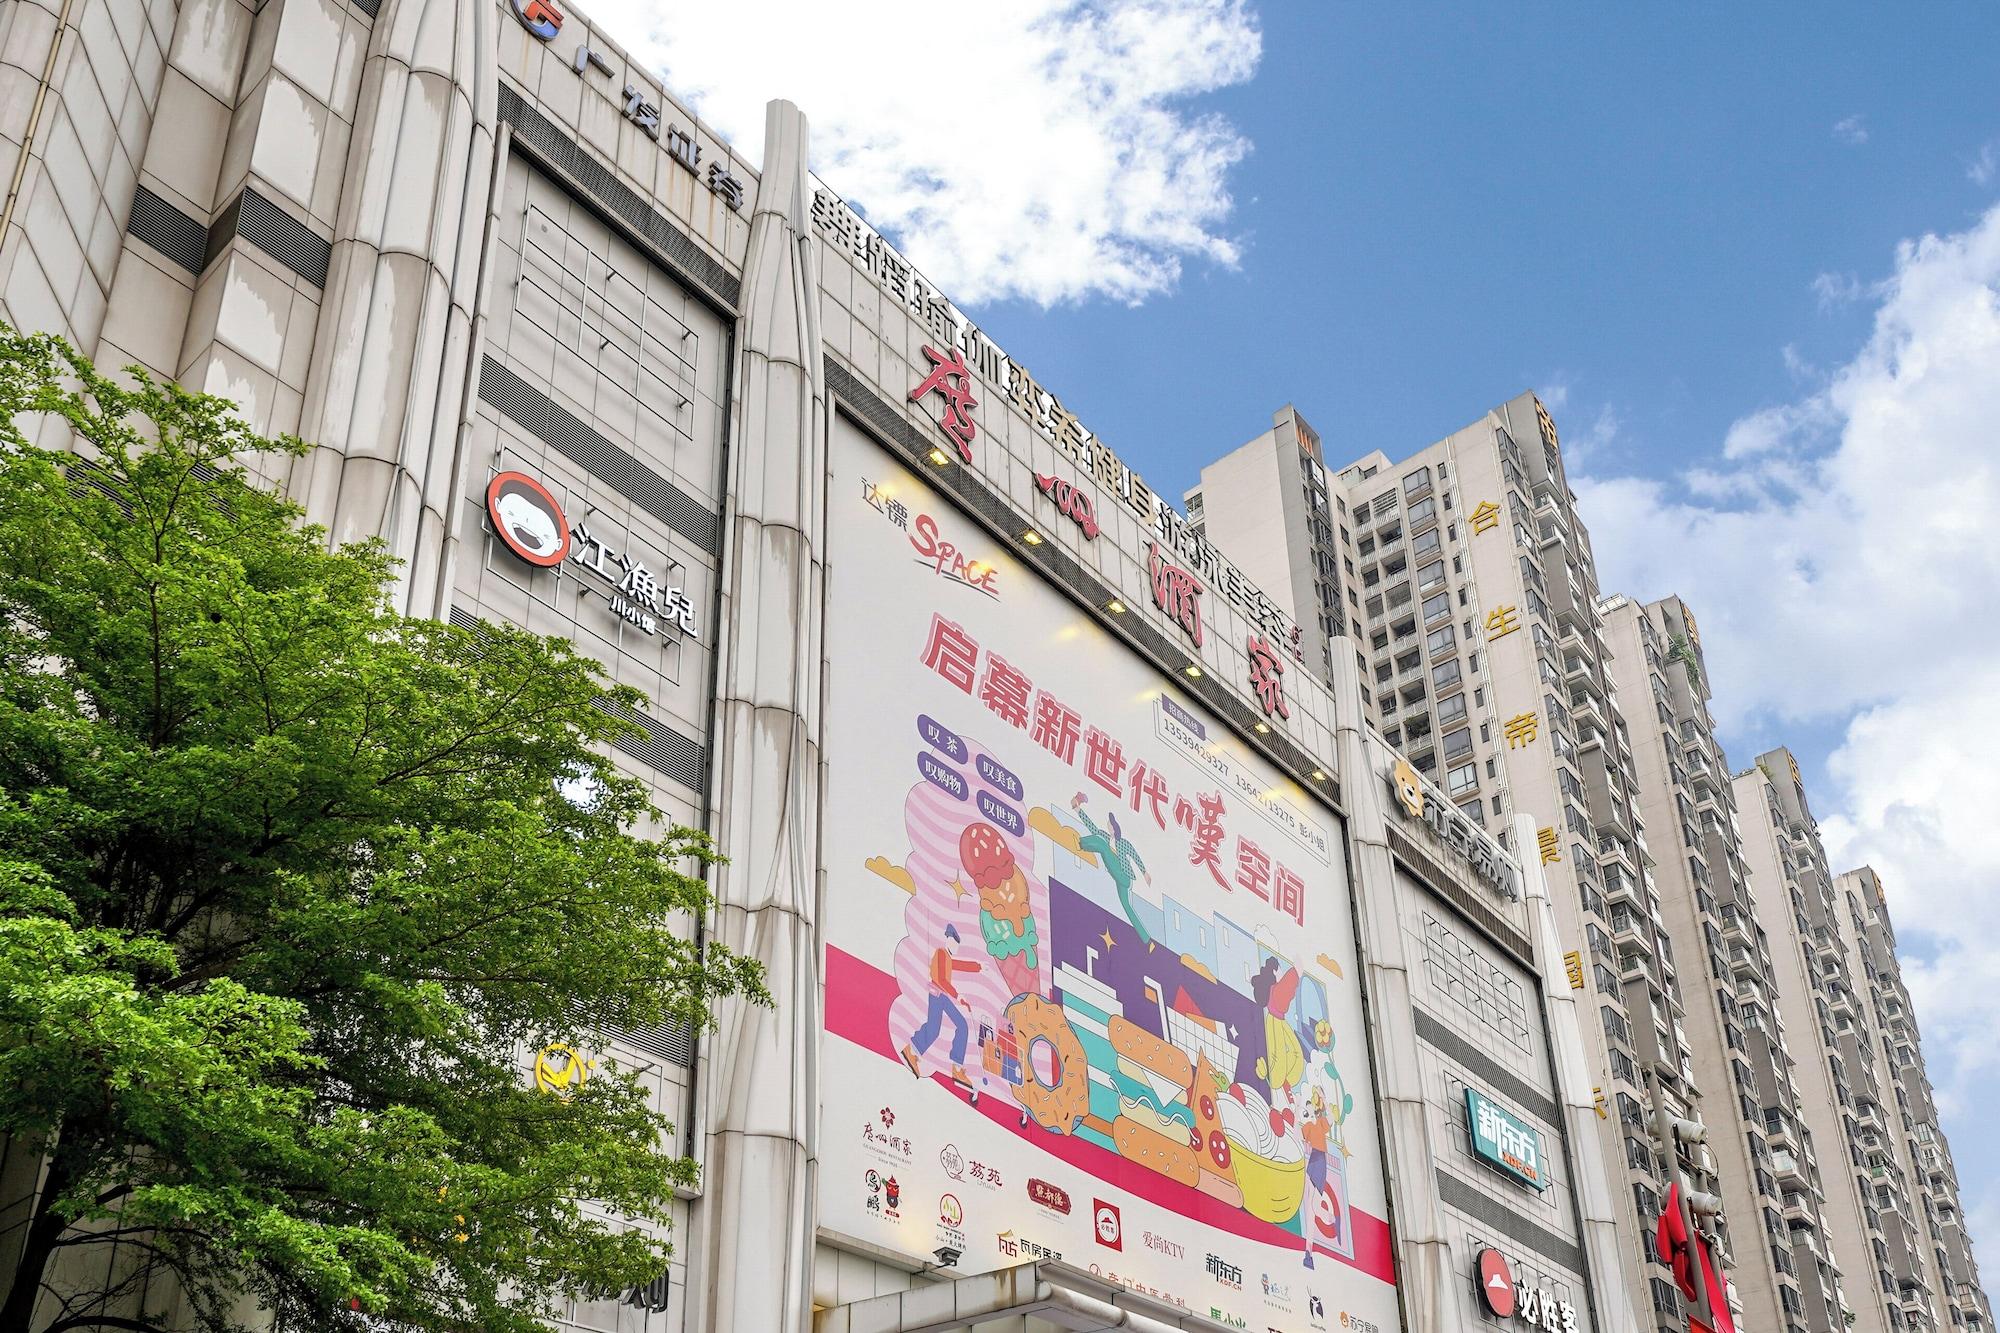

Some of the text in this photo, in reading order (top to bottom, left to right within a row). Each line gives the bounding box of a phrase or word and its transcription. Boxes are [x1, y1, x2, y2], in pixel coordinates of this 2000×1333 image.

[925, 760, 961, 795] 叹购物
[983, 760, 1017, 794] 叹美食
[983, 798, 1018, 830] 叹世界
[1478, 1100, 1536, 1169] 新东方
[969, 1160, 1003, 1187] 荔苑
[1142, 1231, 1185, 1260] 爱尚KTV
[1205, 1251, 1242, 1285] 新东方
[1518, 1278, 1579, 1333] 必胜客
